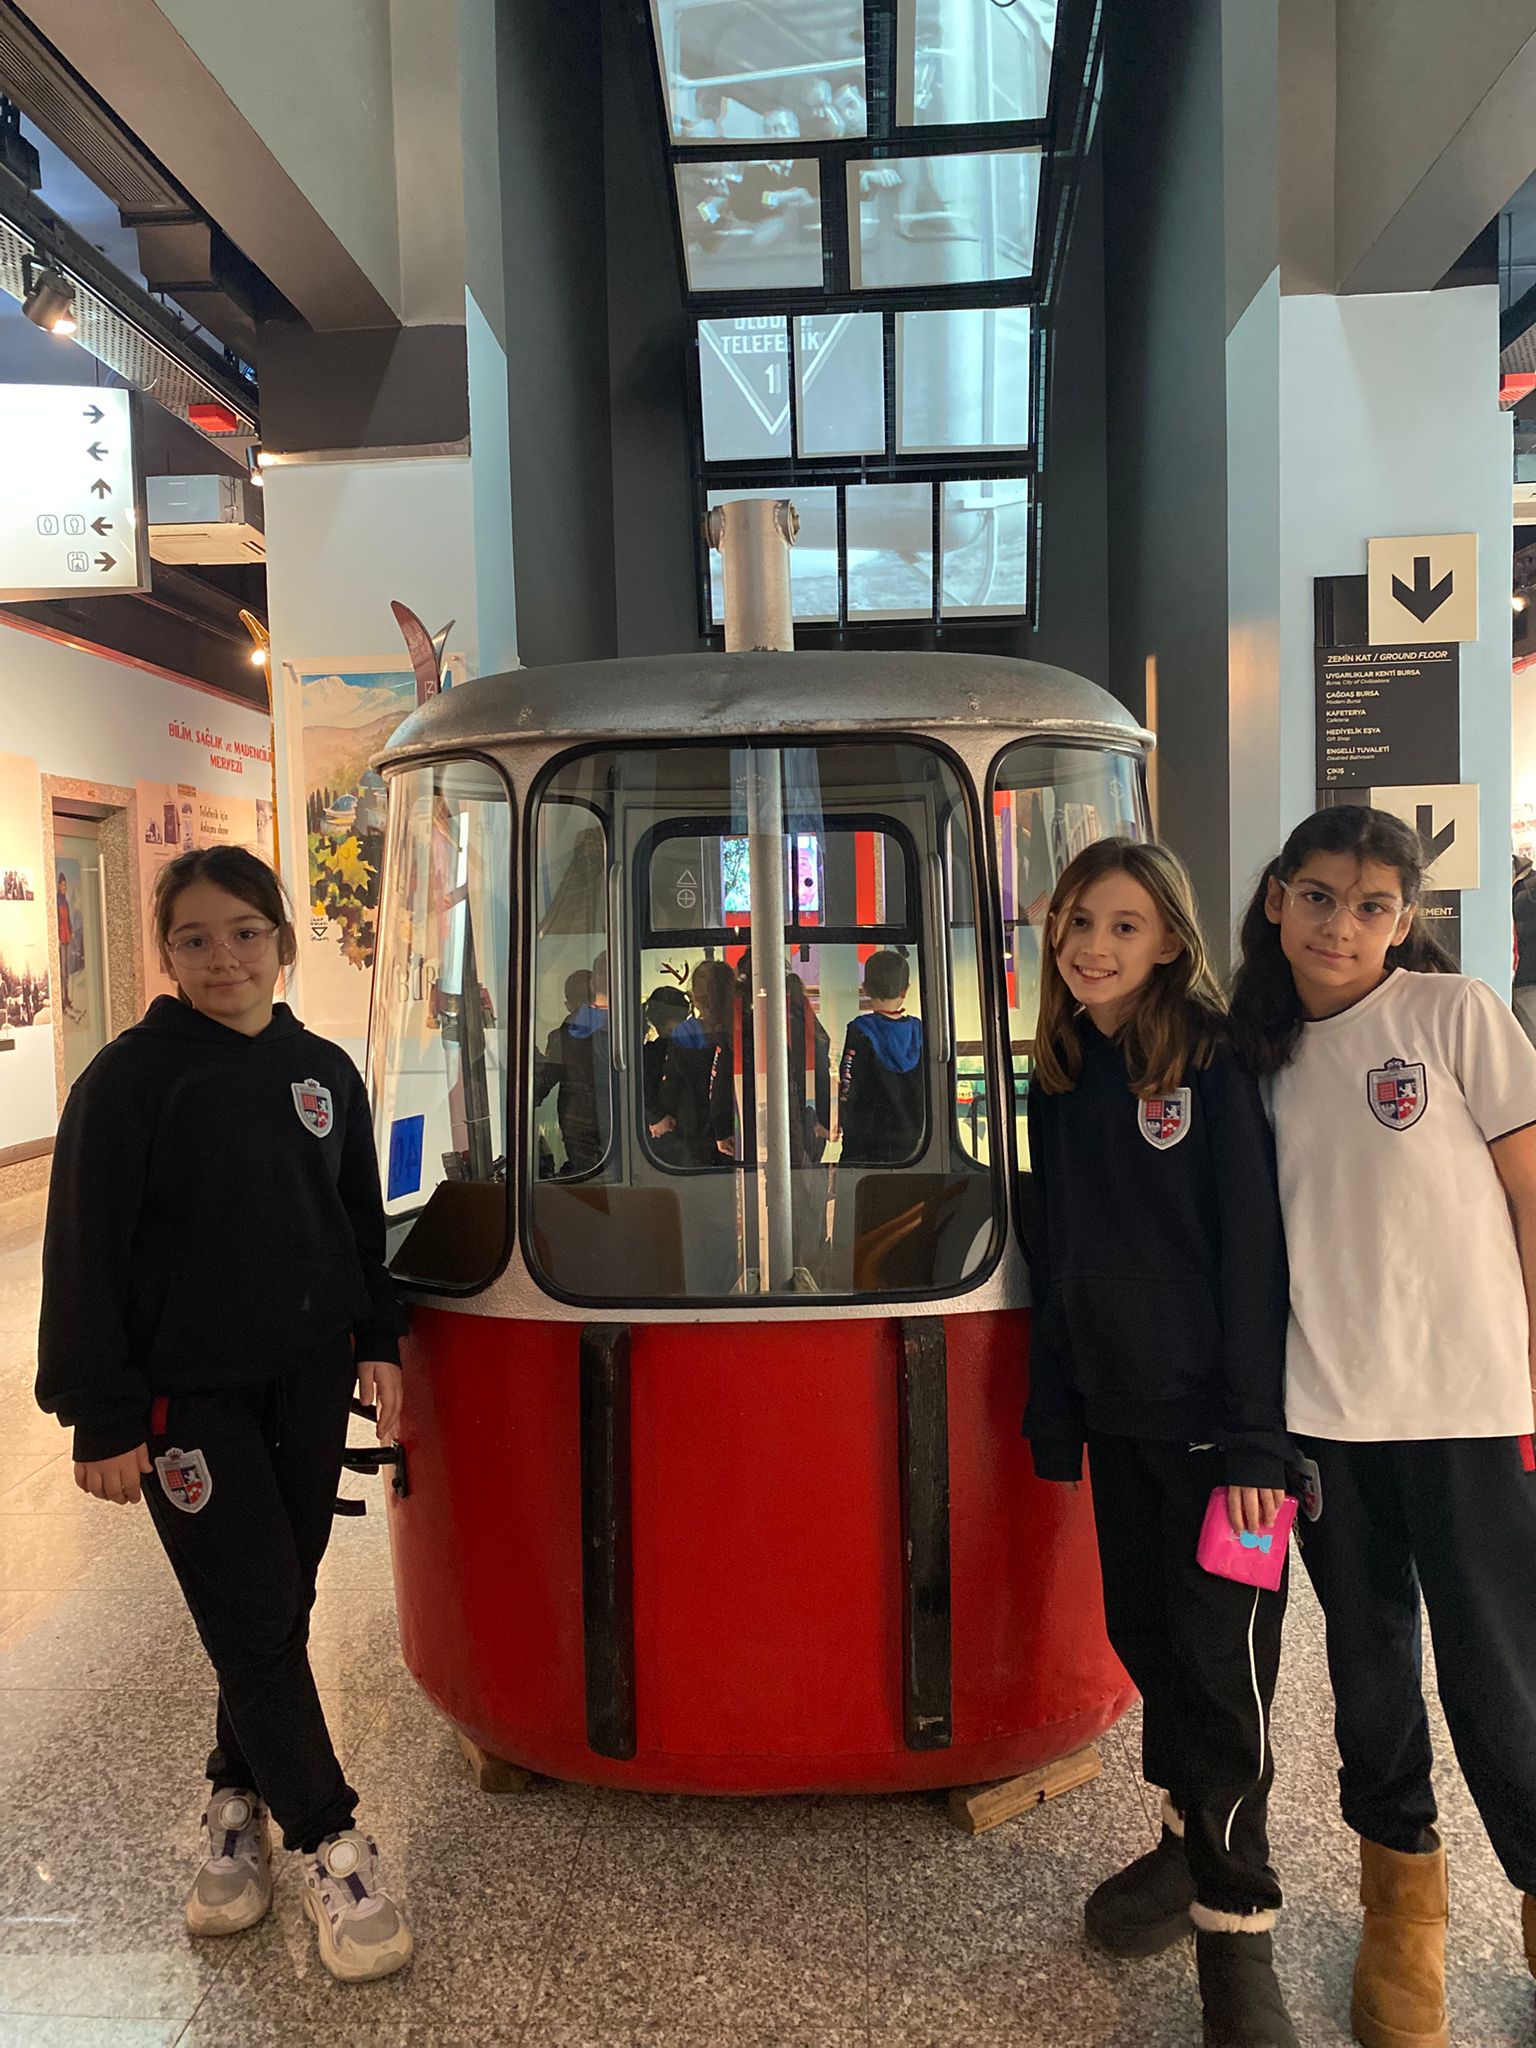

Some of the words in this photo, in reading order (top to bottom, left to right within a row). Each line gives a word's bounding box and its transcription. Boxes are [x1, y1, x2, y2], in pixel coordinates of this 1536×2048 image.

[720, 328, 820, 354] TELEFEİK
[1327, 653, 1354, 664] ZEMİN
[1355, 653, 1372, 662] KAT
[1373, 653, 1378, 662] /
[1379, 652, 1417, 661] GROUND
[1418, 650, 1448, 660] FLOOR
[1325, 671, 1374, 679] UYGARLIKLAR
[1375, 669, 1396, 677] KENTİ
[1325, 691, 1355, 699] ÇAĞDAŞ
[1326, 709, 1367, 717] KAFETERYA
[1326, 728, 1362, 736] HEDİYELİK
[1363, 727, 1381, 735] EŞYA
[233, 741, 271, 762] MADENCİLİ
[1326, 747, 1356, 755] ENGELLİ
[1357, 745, 1390, 753] TUVALETİ
[210, 754, 243, 774] MERKEZİ
[1420, 907, 1454, 917] EMENT
